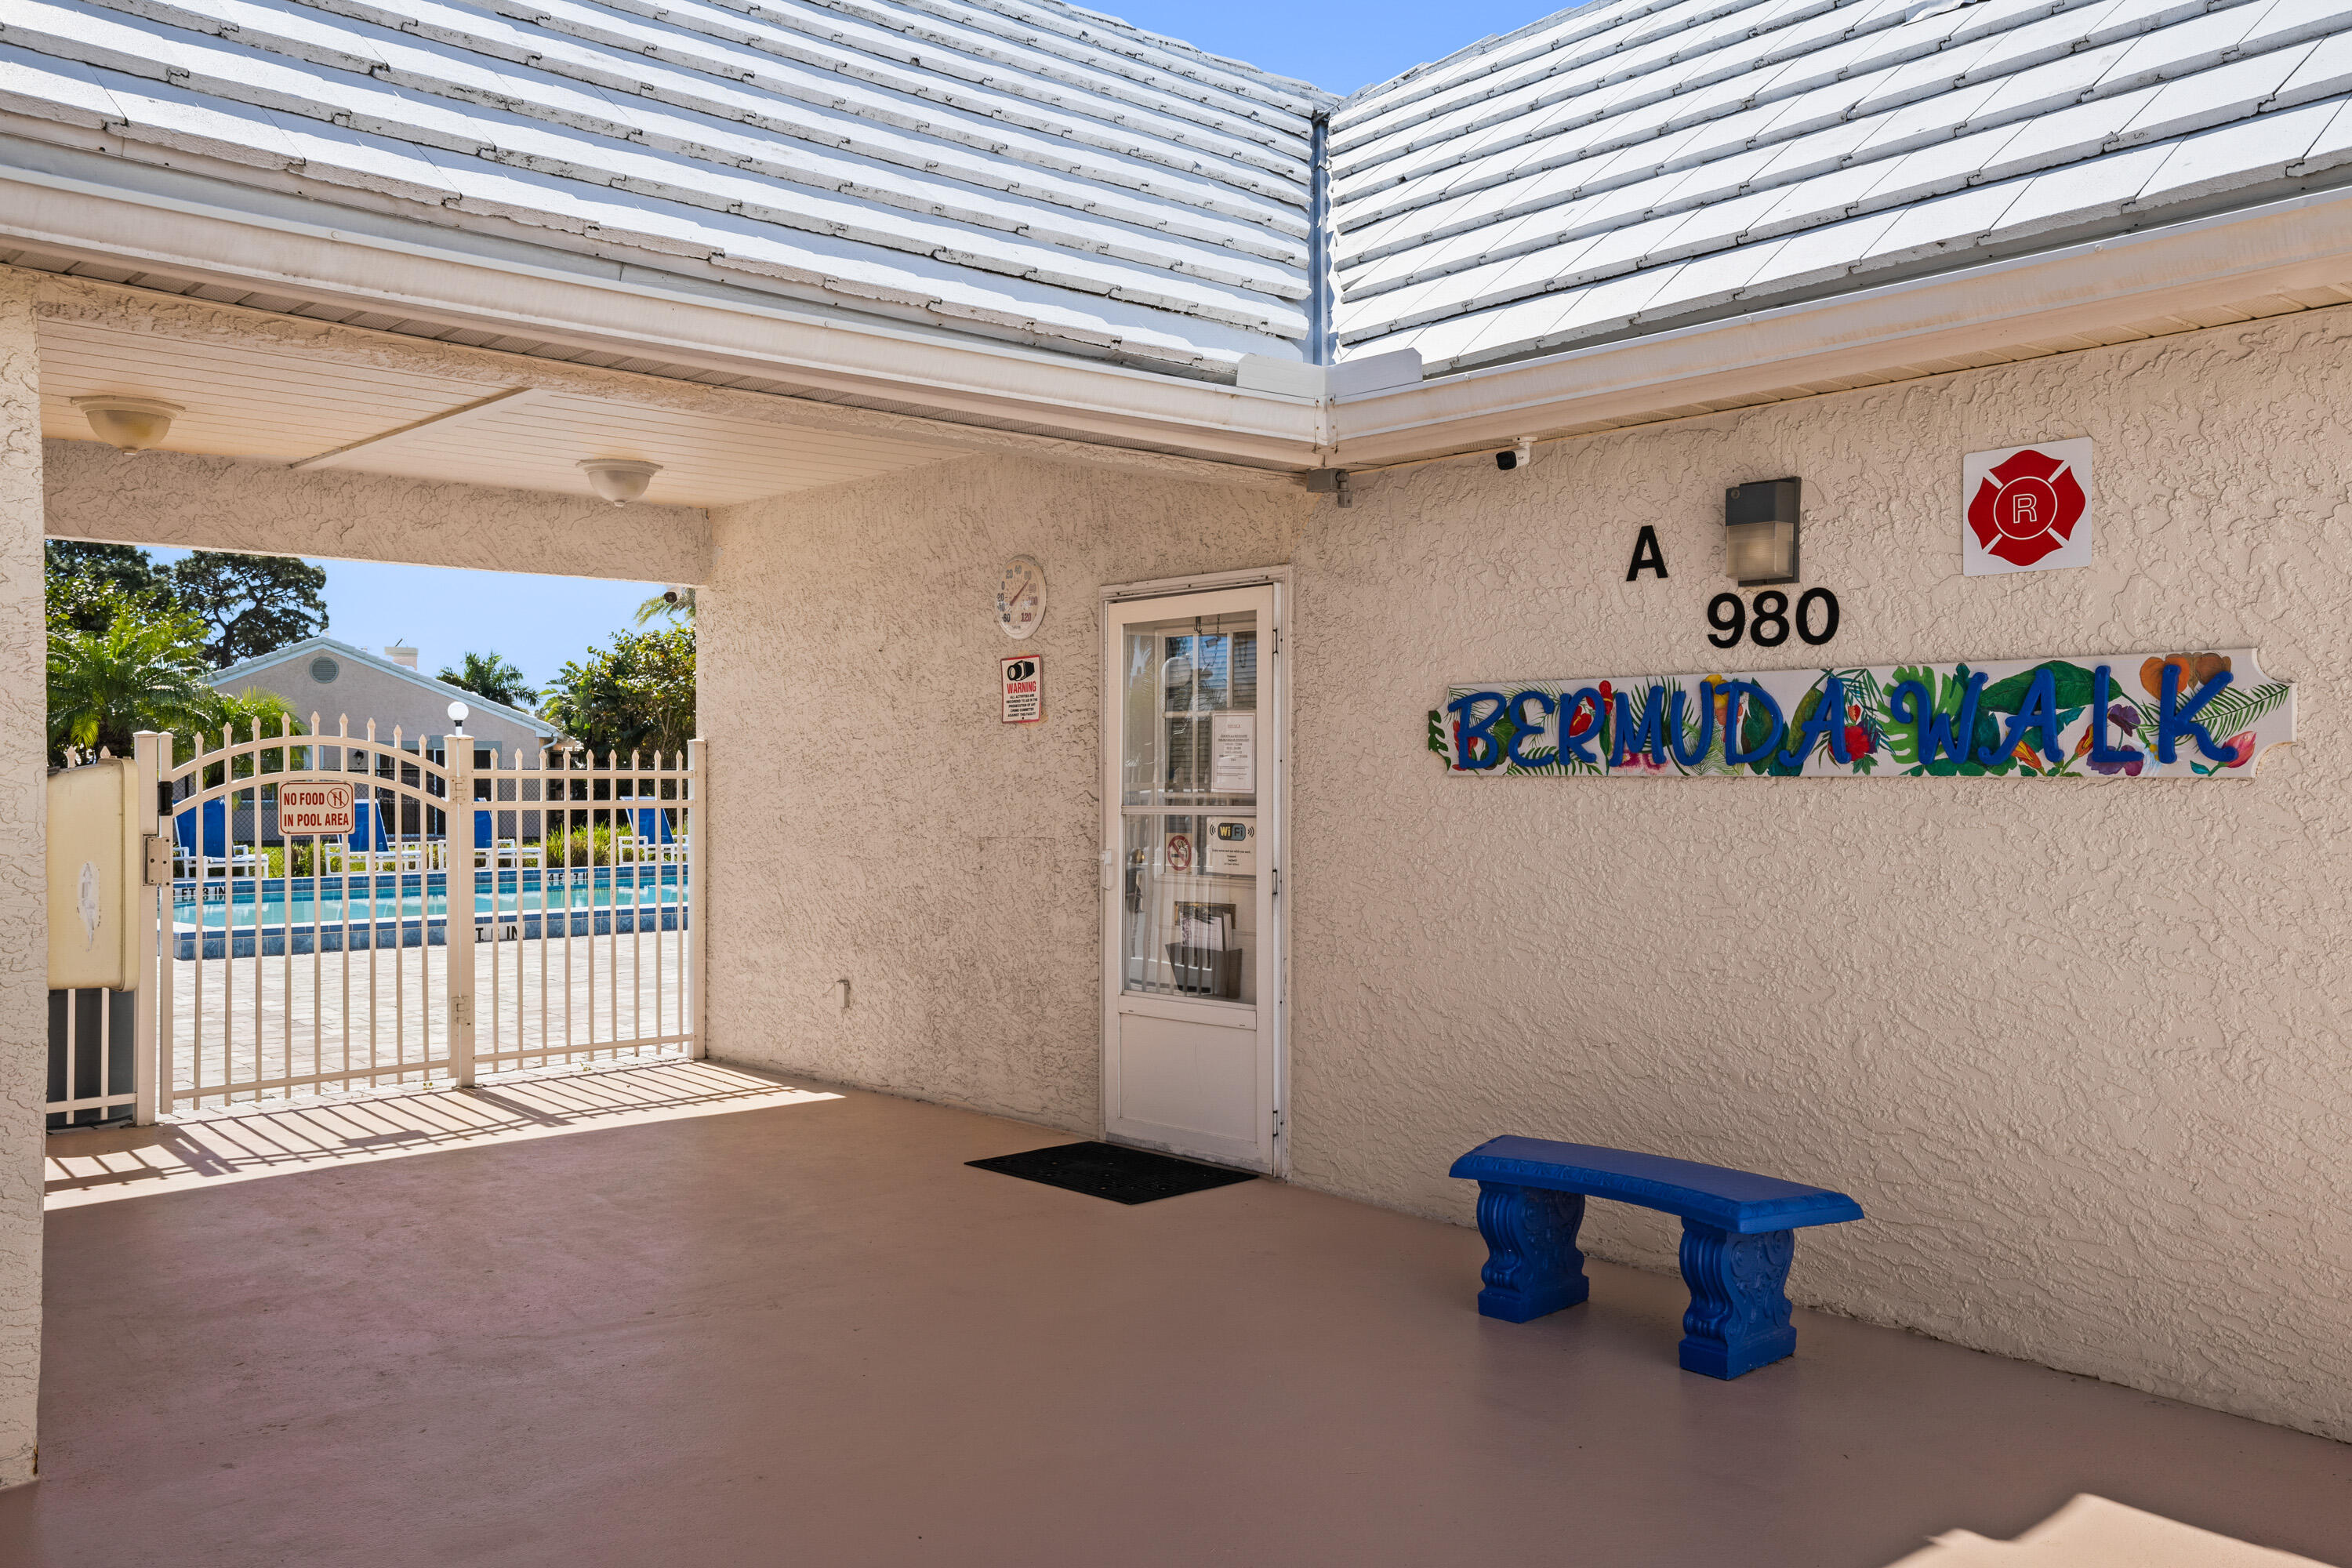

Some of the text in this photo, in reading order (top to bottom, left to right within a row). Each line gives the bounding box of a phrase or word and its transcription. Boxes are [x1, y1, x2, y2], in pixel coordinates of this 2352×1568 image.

[2013, 493, 2038, 524] R
[1626, 524, 1668, 582] A
[1021, 612, 1032, 622] 120
[1707, 587, 1840, 648] 980
[1007, 681, 1036, 694] WARNING
[1447, 664, 2240, 769] BERMUDA WALK
[284, 792, 325, 806] NO FOOD
[284, 812, 349, 827] IN POOL AREA
